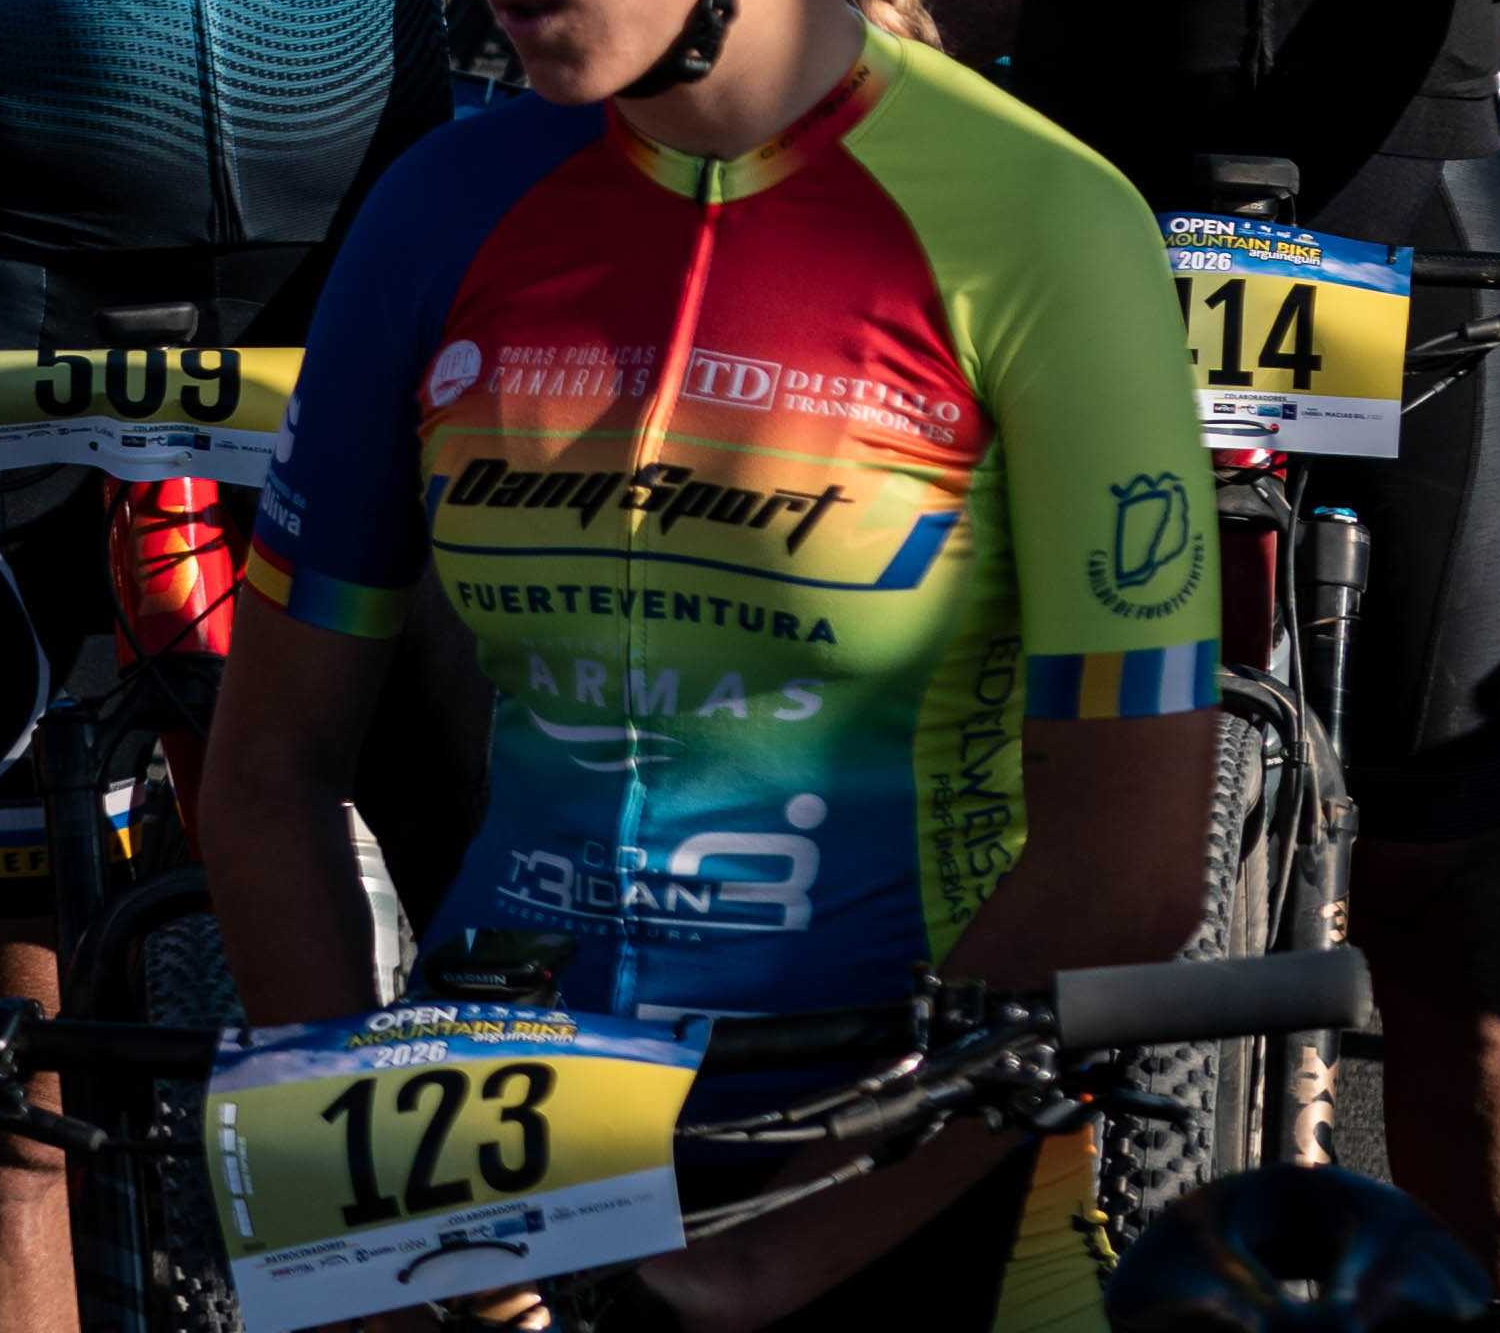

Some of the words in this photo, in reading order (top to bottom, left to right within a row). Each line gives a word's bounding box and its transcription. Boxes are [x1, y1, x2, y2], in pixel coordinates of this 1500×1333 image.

[1169, 216, 1235, 236] OPEN
[1176, 250, 1232, 272] 2026
[1276, 240, 1322, 261] BIKE
[499, 344, 558, 366] OBRAS
[34, 347, 243, 423] 509
[486, 364, 651, 400] CANARIAS
[693, 358, 775, 405] TD
[1224, 393, 1287, 402] COLABORADORES
[783, 392, 957, 446] TRANSPORTES
[456, 581, 838, 646] FUERTEVENTURA
[526, 652, 827, 722] ARMAS
[441, 970, 508, 987] GARMIN
[365, 1005, 459, 1033] OPEN
[346, 1020, 506, 1050] MOUNTAIN
[513, 1020, 578, 1039] BIKE
[371, 1041, 450, 1069] 2026
[319, 1060, 560, 1229] 123
